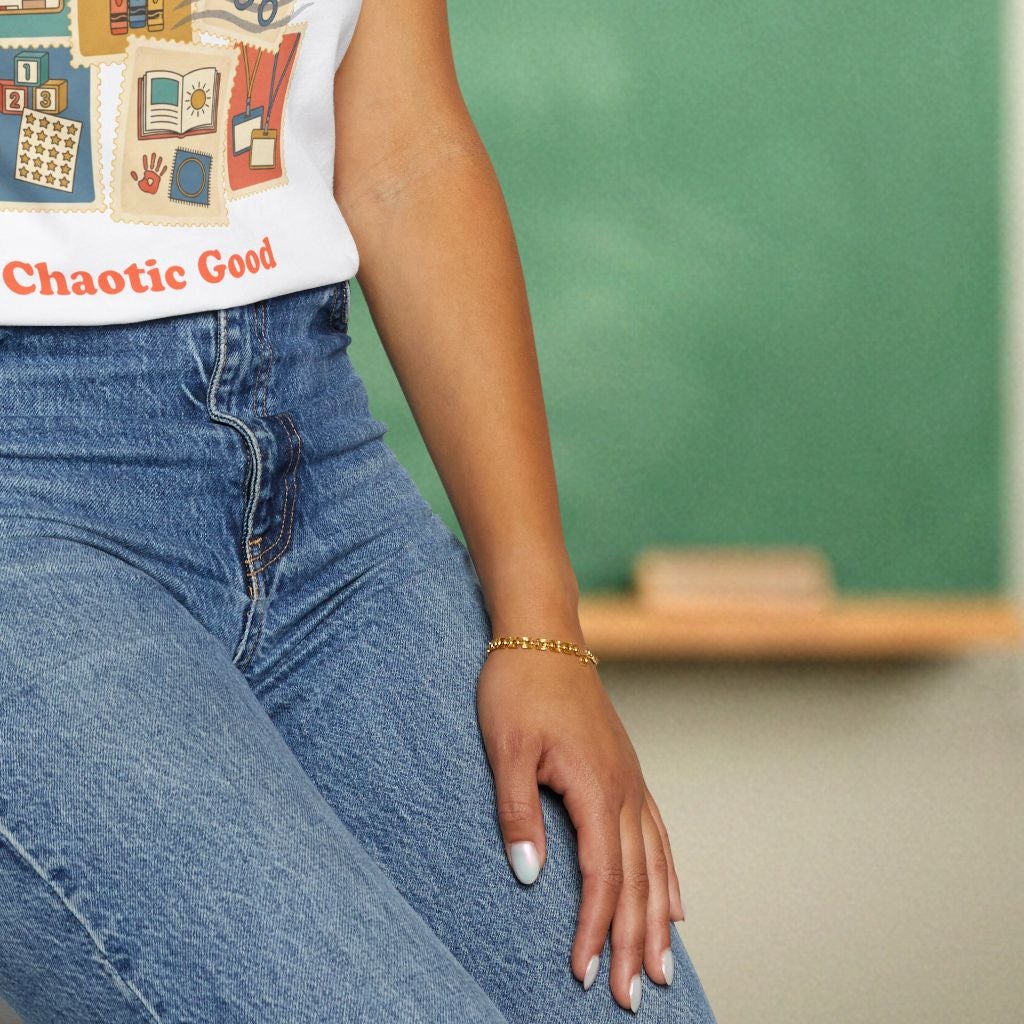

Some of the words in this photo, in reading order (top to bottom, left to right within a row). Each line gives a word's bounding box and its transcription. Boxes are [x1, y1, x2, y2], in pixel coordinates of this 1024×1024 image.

[22, 63, 31, 81] 1
[9, 91, 21, 109] 2
[40, 90, 52, 108] 3
[2, 259, 188, 296] Chaotic
[197, 236, 278, 284] Good
